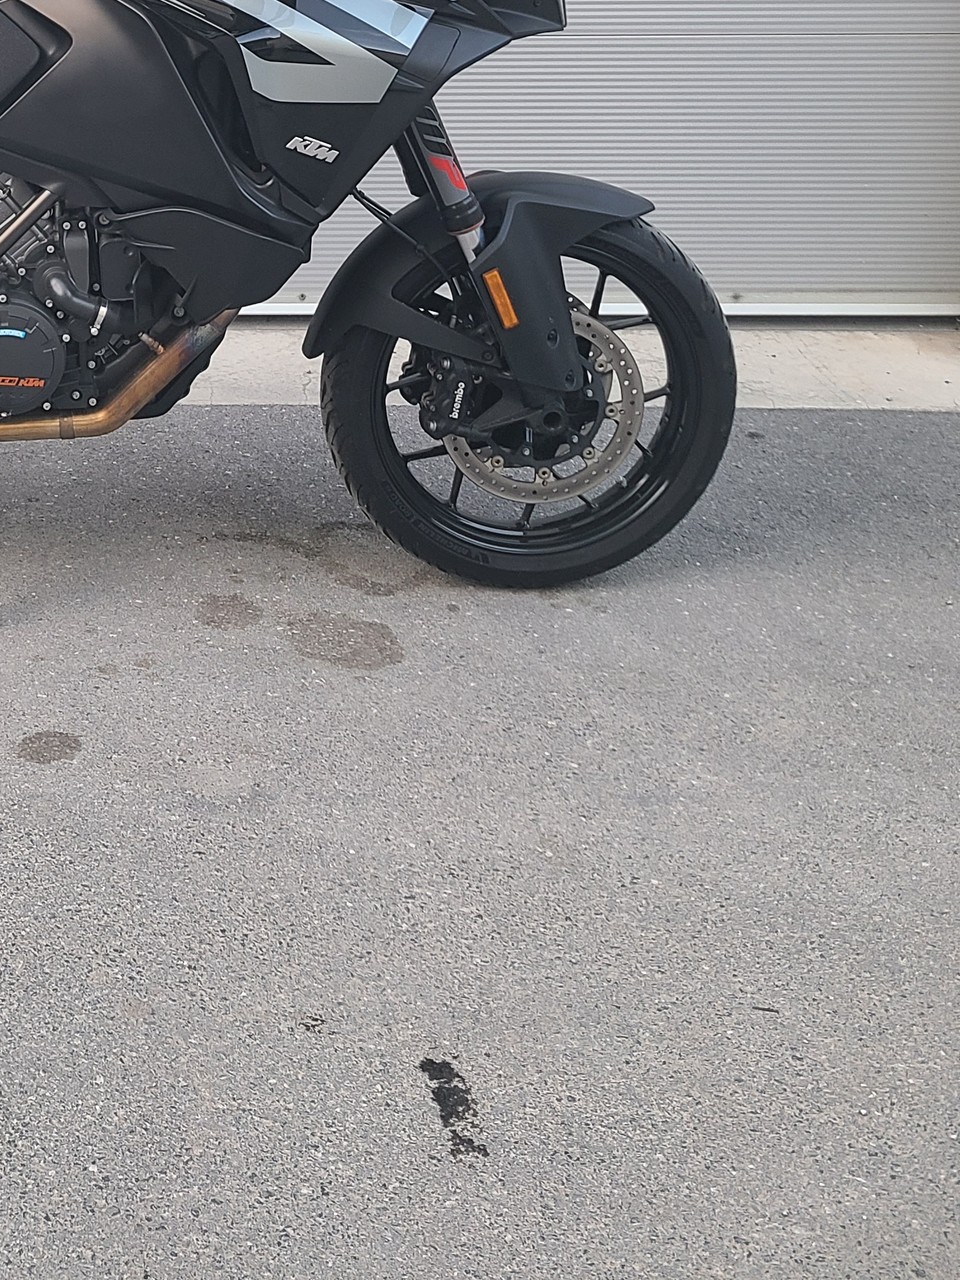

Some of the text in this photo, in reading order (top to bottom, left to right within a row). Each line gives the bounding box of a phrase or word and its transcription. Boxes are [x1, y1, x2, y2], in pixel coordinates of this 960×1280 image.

[285, 136, 340, 163] KTM
[18, 377, 45, 388] KTM
[449, 381, 465, 419] brembo
